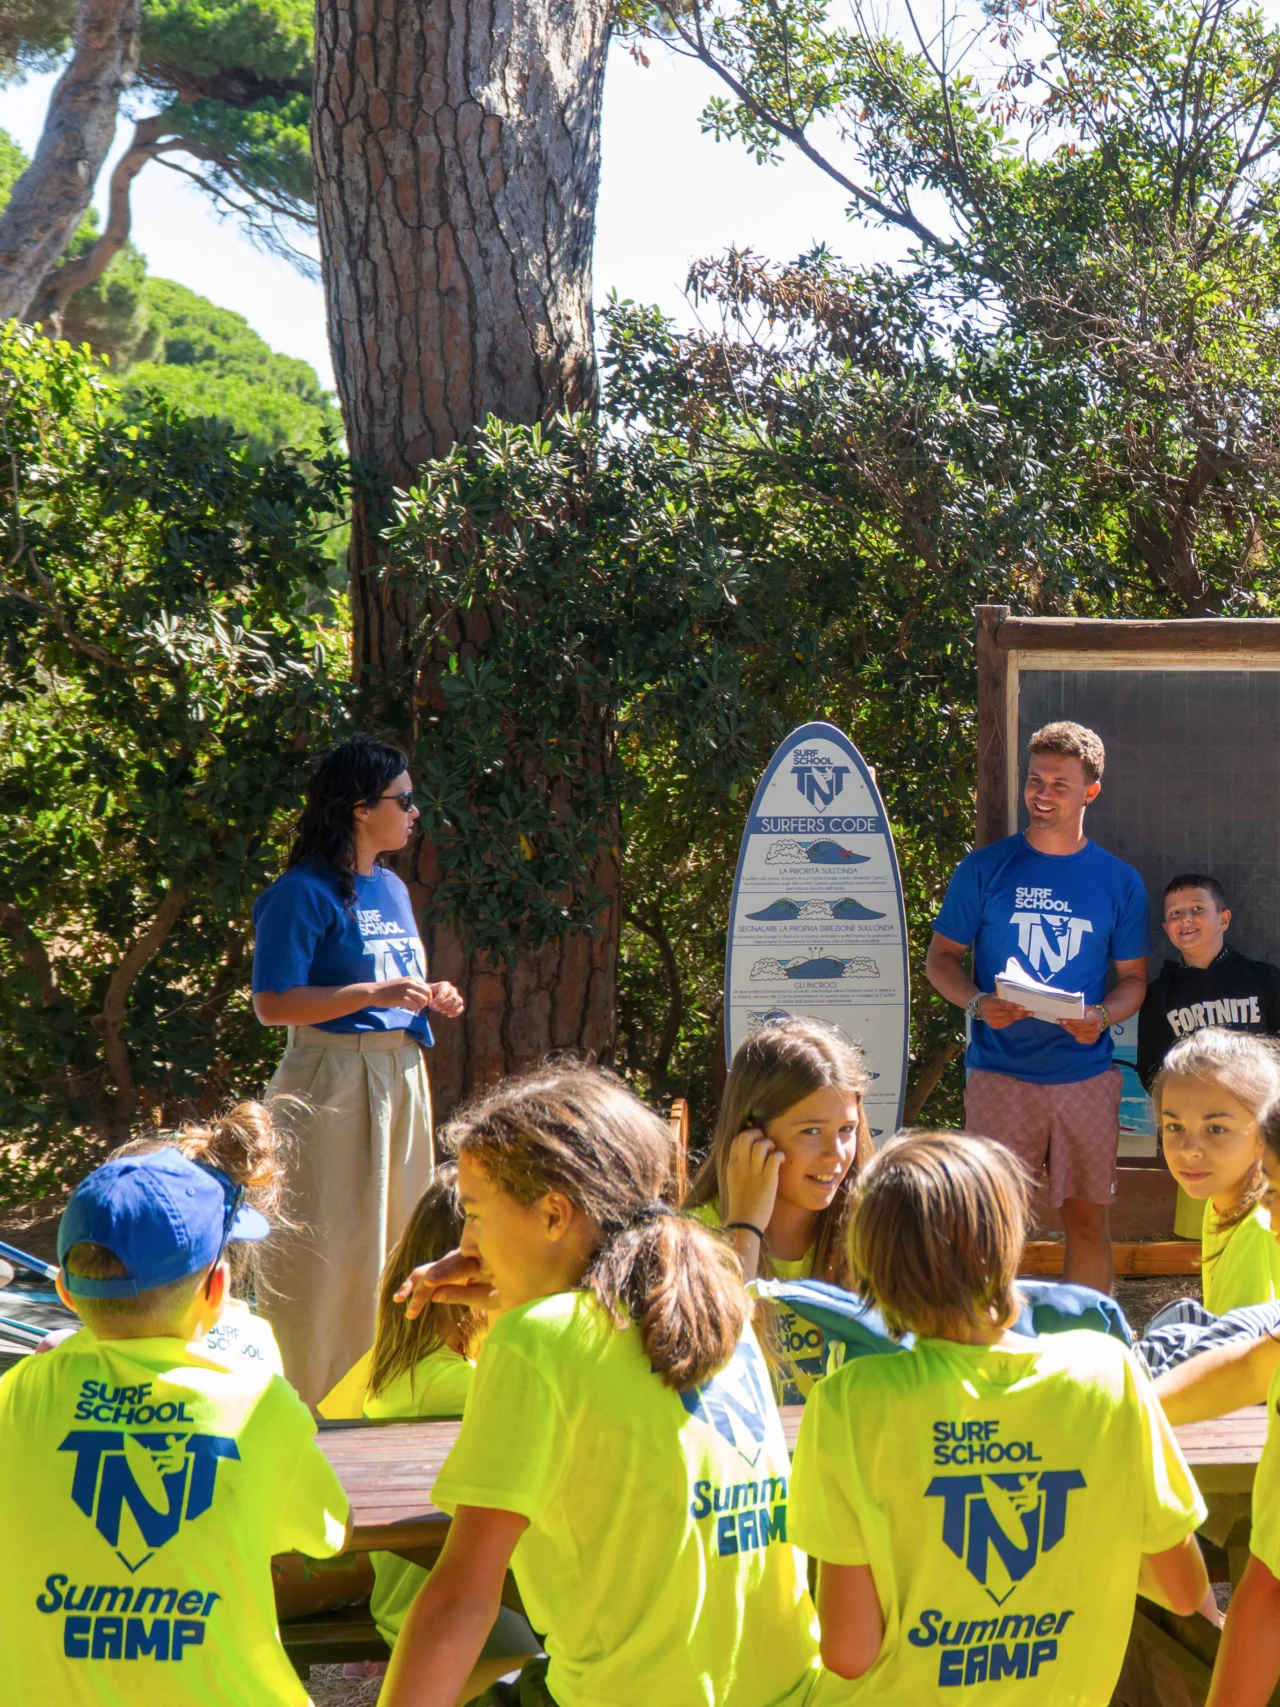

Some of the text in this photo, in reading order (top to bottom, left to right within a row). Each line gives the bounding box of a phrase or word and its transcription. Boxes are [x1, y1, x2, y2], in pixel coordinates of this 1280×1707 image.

[793, 749, 819, 757] SURF
[793, 757, 834, 765] SCHOOL
[790, 766, 851, 806] TNT
[761, 818, 876, 832] SURFERS CODE
[1015, 887, 1052, 898] SURF
[1015, 897, 1073, 913] SCHOOL
[1009, 912, 1093, 973] TNT
[1166, 996, 1261, 1037] FORTNITE
[80, 1380, 152, 1405] SURF
[74, 1401, 193, 1425] SCHOOL
[933, 1420, 999, 1442] SURF
[933, 1442, 1042, 1465] SCHOOL
[57, 1430, 241, 1548] TNT
[690, 1476, 787, 1519] Summ
[718, 1505, 787, 1558] CAM
[924, 1469, 1087, 1585] TNT
[36, 1573, 222, 1617] Summer
[63, 1615, 206, 1662] CAMP
[908, 1609, 1075, 1648] Summer
[938, 1638, 1058, 1687] CAMP
